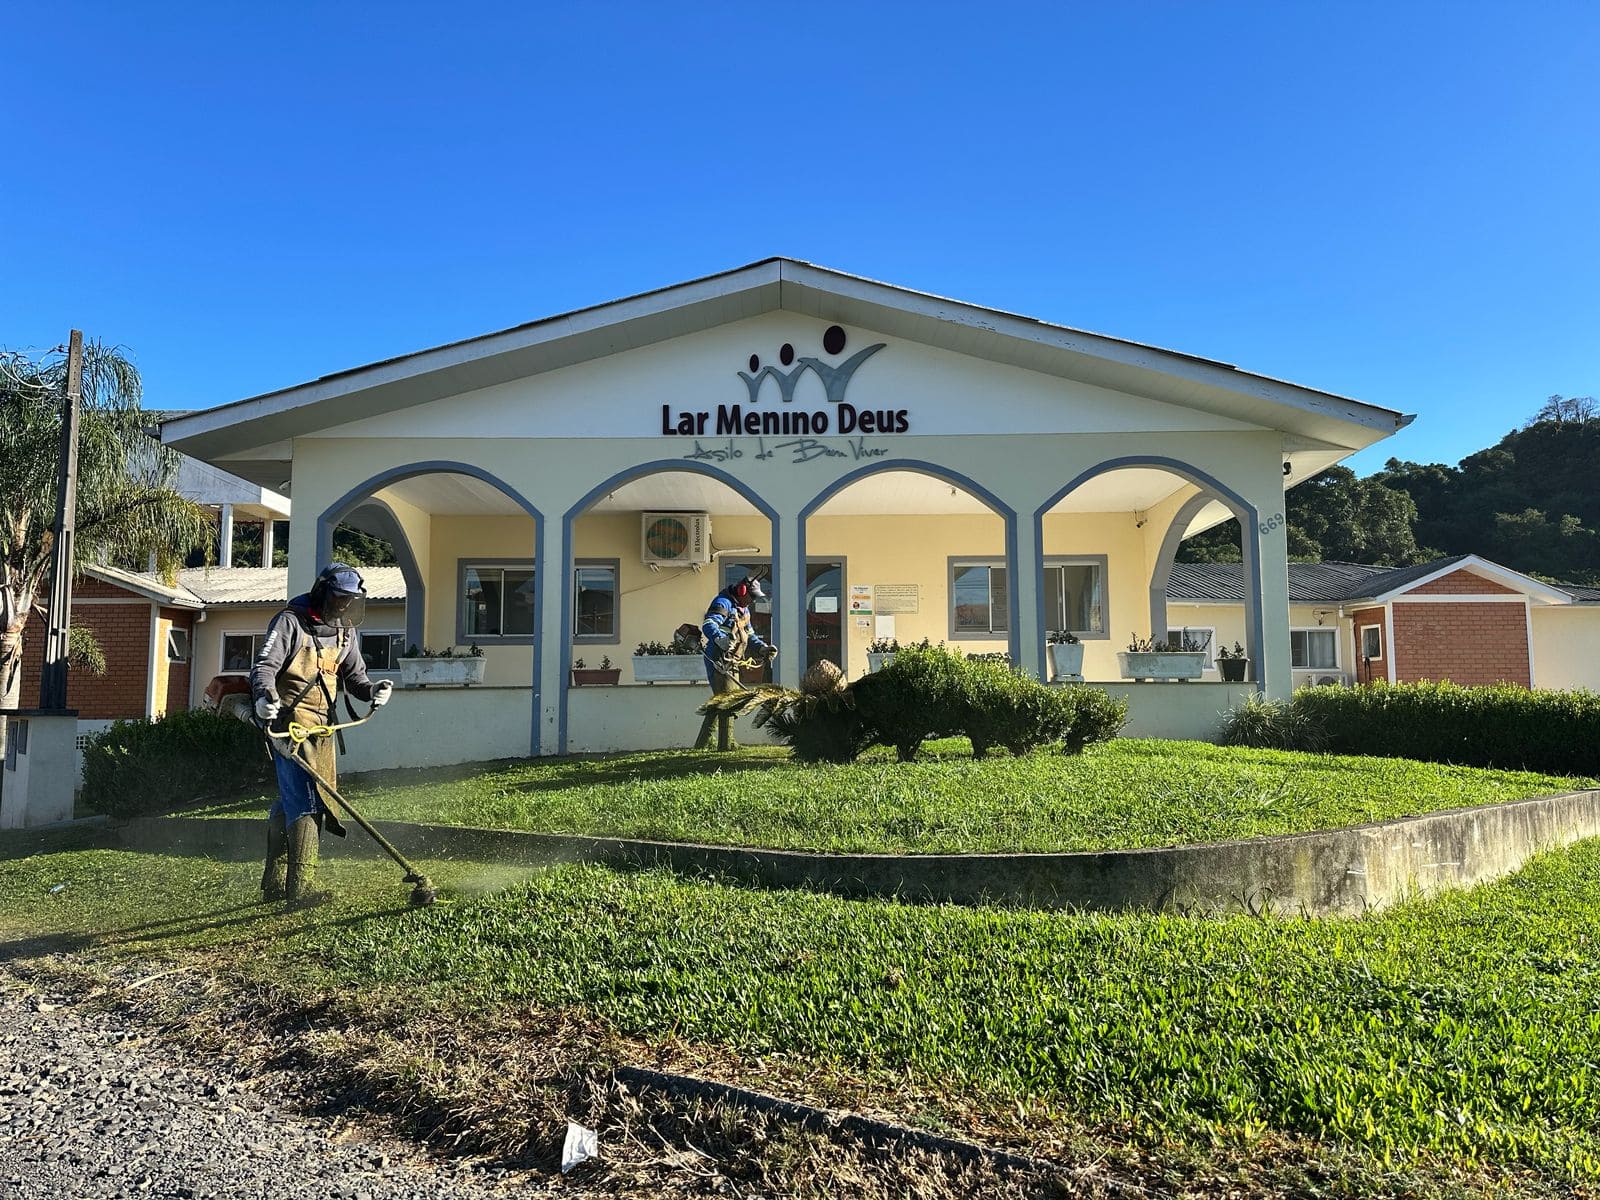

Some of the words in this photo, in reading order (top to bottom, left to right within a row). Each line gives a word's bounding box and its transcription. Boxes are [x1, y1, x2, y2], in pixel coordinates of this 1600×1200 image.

[662, 404, 709, 436] Lar
[716, 403, 829, 435] Menino
[837, 403, 909, 433] Deus
[848, 436, 888, 461] Viver
[1259, 512, 1284, 535] 669
